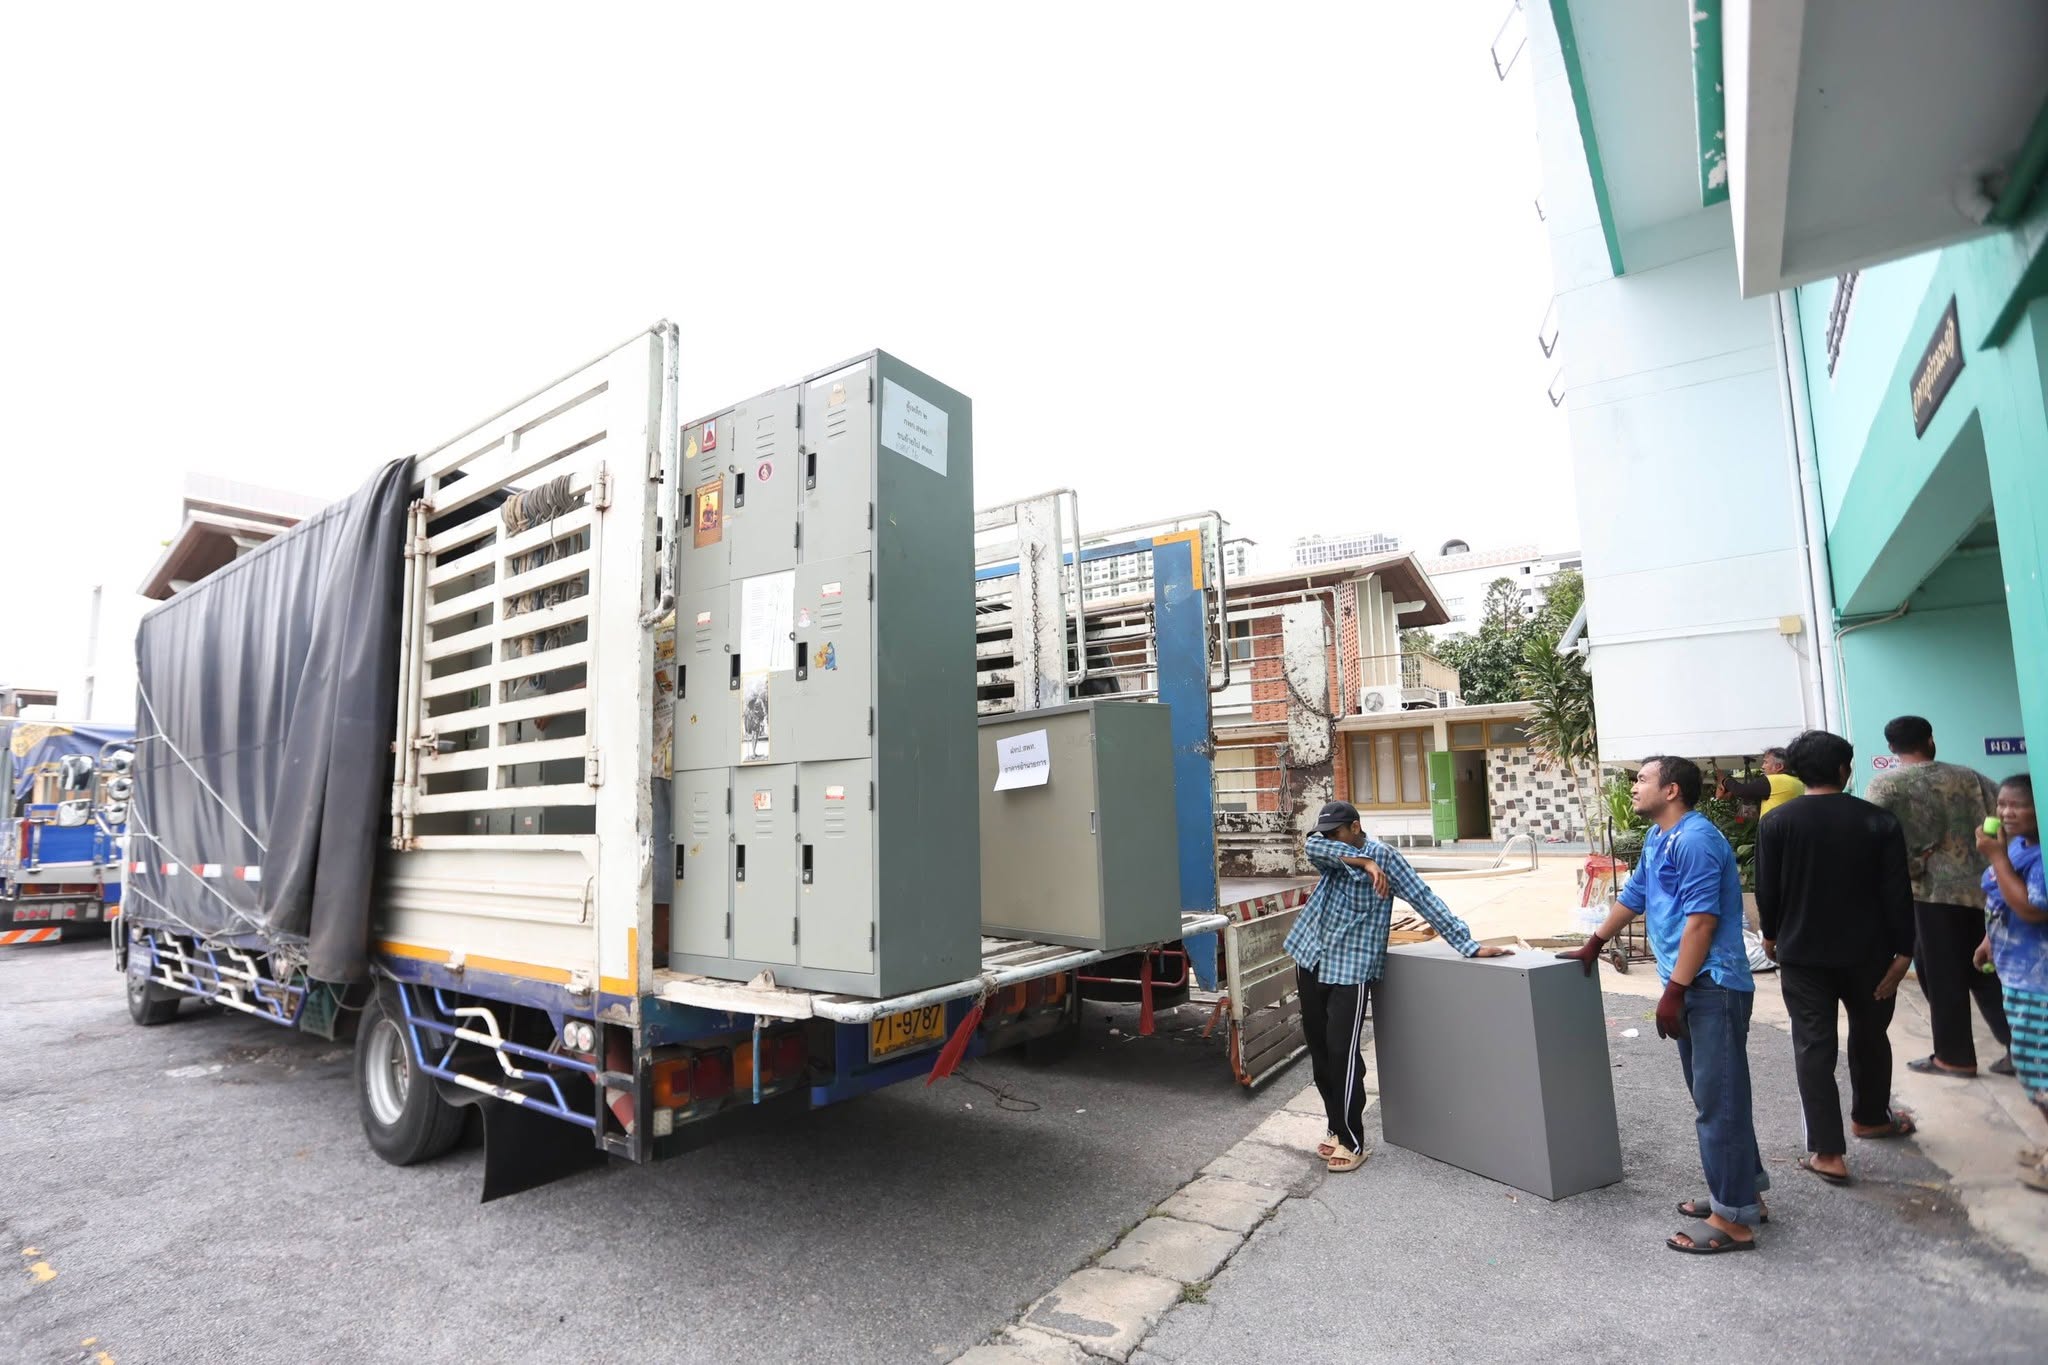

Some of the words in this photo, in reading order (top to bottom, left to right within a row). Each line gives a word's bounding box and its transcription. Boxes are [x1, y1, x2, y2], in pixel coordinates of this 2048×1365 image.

[906, 401, 922, 416] ตู้เหล็ก
[897, 431, 920, 448] ขนย้ายไป
[1004, 760, 1047, 773] อาคารอำนวยการ
[875, 1004, 941, 1043] 71-9787
